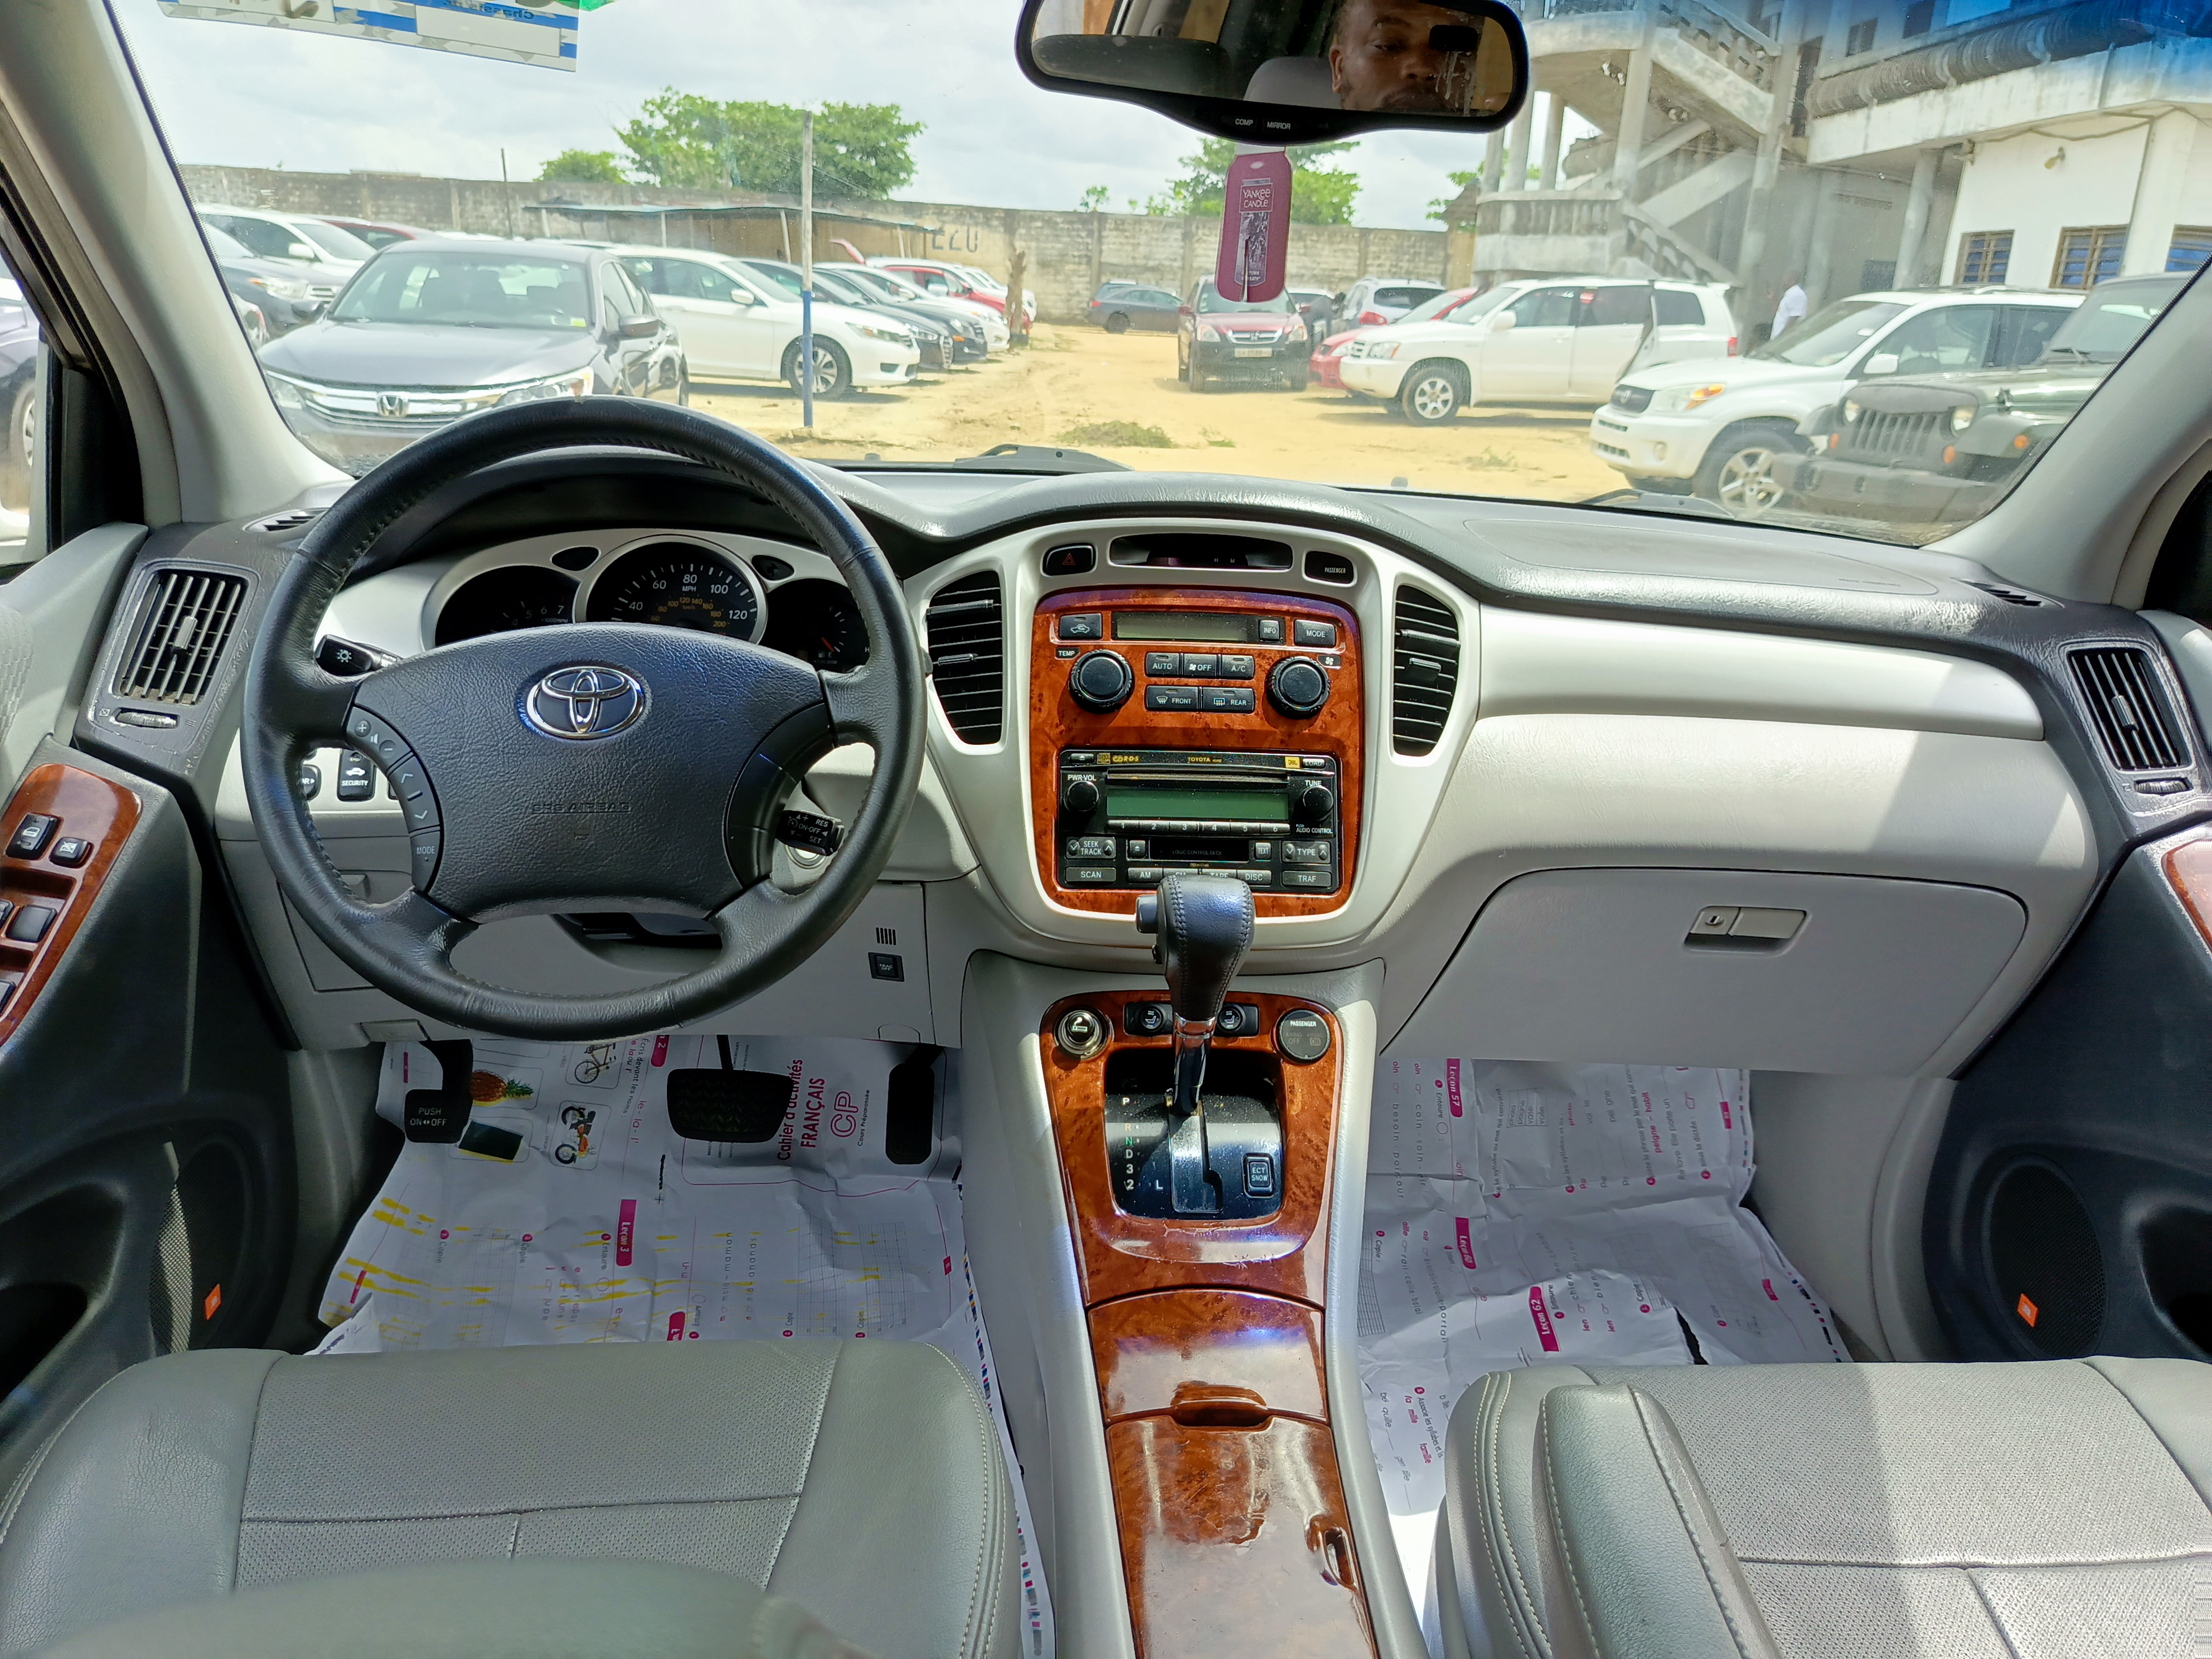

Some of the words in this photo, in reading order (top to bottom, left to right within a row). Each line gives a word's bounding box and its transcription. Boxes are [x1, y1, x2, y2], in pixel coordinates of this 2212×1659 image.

[1235, 118, 1254, 127] COMP
[1267, 122, 1291, 130] MIRROR
[652, 580, 667, 589] 60
[683, 574, 697, 584] 80
[710, 584, 729, 595] 100
[541, 606, 547, 614] 6
[558, 605, 565, 614] 7
[628, 601, 643, 610] 40
[526, 610, 533, 619] 5
[729, 610, 748, 620] 120
[1306, 629, 1326, 638] MODE
[816, 818, 829, 828] RES
[809, 835, 822, 845] SET
[416, 846, 435, 855] MODE
[638, 1038, 651, 1055] Écris
[633, 1057, 644, 1082] devant
[1448, 1066, 1458, 1092] Leçon
[630, 1084, 639, 1094] les
[623, 1096, 635, 1114] noms
[1122, 1097, 1129, 1105] P
[1451, 1094, 1461, 1107] 57
[1495, 1088, 1504, 1117] convient
[1629, 1096, 1638, 1109] mot
[1662, 1098, 1670, 1109] un
[419, 1107, 442, 1115] PUSH
[801, 1077, 825, 1148] FRANÇAIS
[830, 1091, 859, 1137] CP
[858, 1089, 870, 1127] Préparatoire
[1566, 1103, 1575, 1126] photo
[410, 1118, 422, 1126] ON
[431, 1118, 448, 1127] OFF
[1124, 1123, 1131, 1131] R
[857, 1128, 865, 1147] Cours
[1690, 1121, 1701, 1142] dictée
[777, 1123, 794, 1161] Cahier
[1125, 1137, 1133, 1146] N
[1638, 1130, 1648, 1153] phrase
[1126, 1149, 1133, 1158] D
[1697, 1152, 1706, 1167] sous
[1126, 1163, 1133, 1174] 3
[1126, 1179, 1134, 1191] 2
[1155, 1179, 1163, 1191] L
[619, 1221, 632, 1245] Leçon
[724, 1233, 733, 1271] maman
[1374, 1239, 1382, 1258] Copie
[600, 1242, 610, 1270] Entoure
[748, 1238, 756, 1277] ananas
[1547, 1284, 1559, 1310] Entoure
[1632, 1283, 1644, 1302] Copie
[1531, 1299, 1542, 1311] 62
[1536, 1312, 1550, 1335] Leçon
[1418, 1397, 1429, 1417] Associe
[1419, 1443, 1432, 1464] famille
